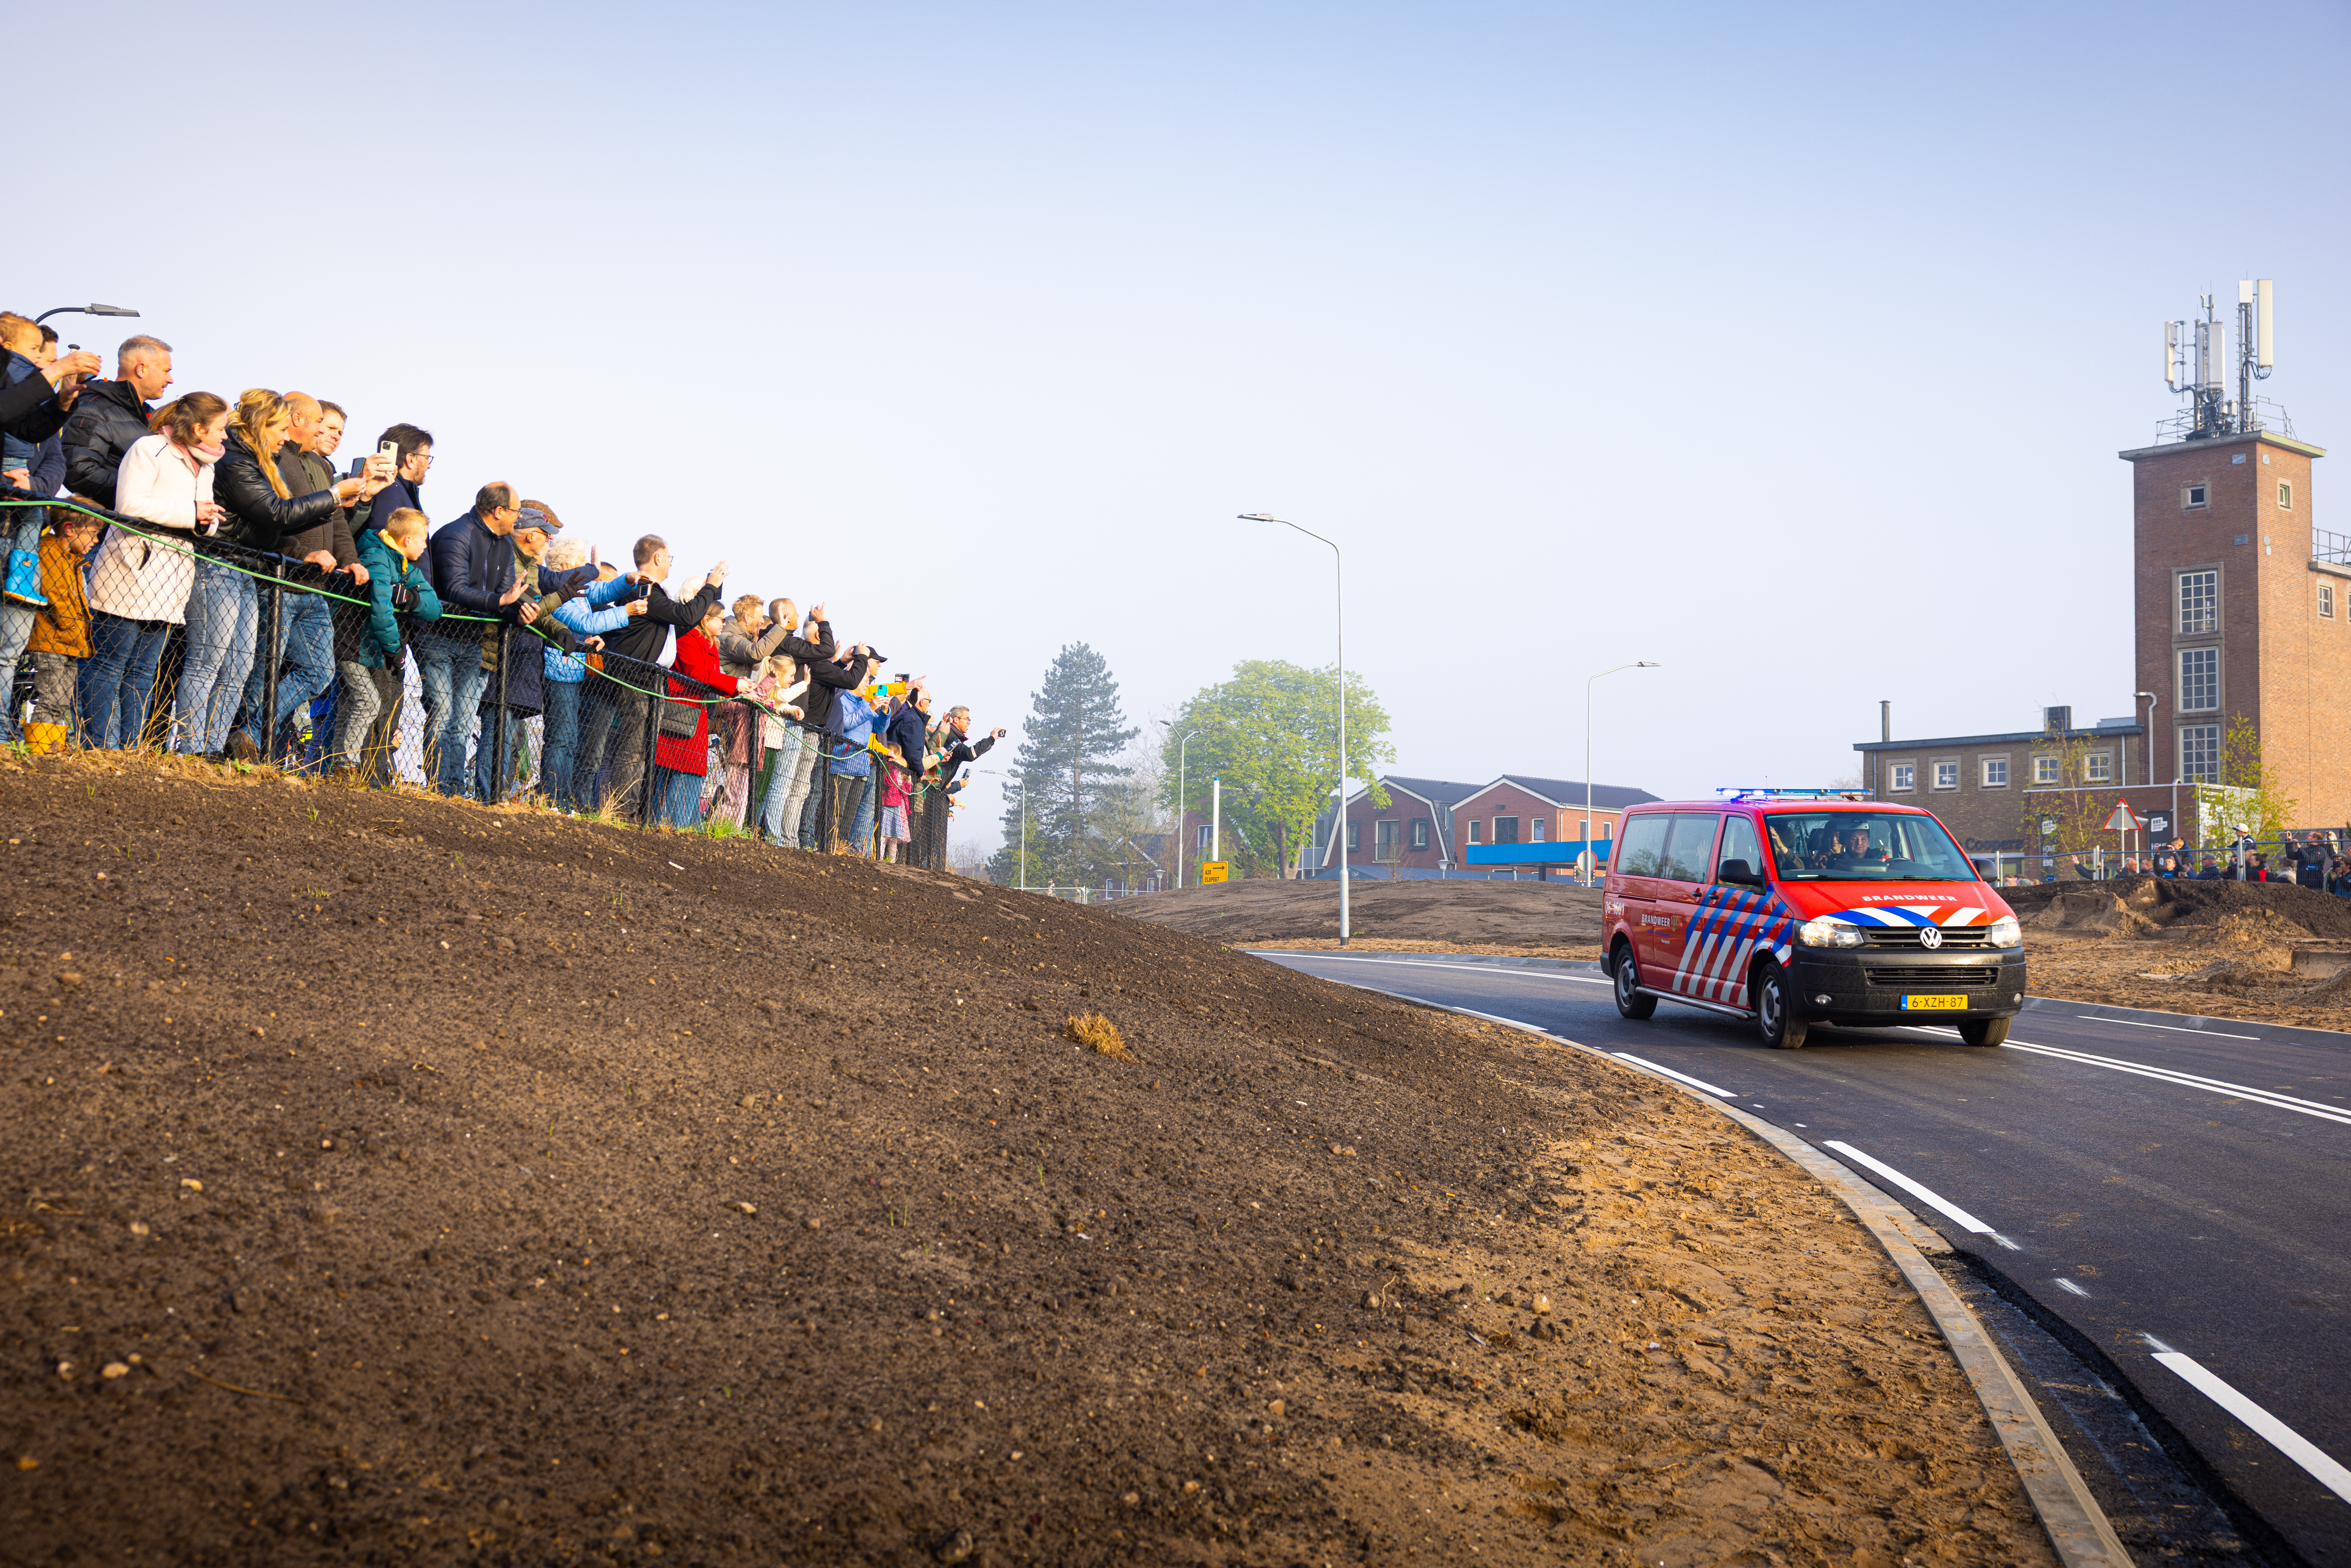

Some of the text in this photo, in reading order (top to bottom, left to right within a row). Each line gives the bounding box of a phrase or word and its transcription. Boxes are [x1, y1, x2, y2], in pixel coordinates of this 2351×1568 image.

[1605, 901, 1625, 916] 06-1601
[1641, 914, 1670, 927] BRANDWEER
[1912, 997, 1963, 1007] 6-XZH-87
